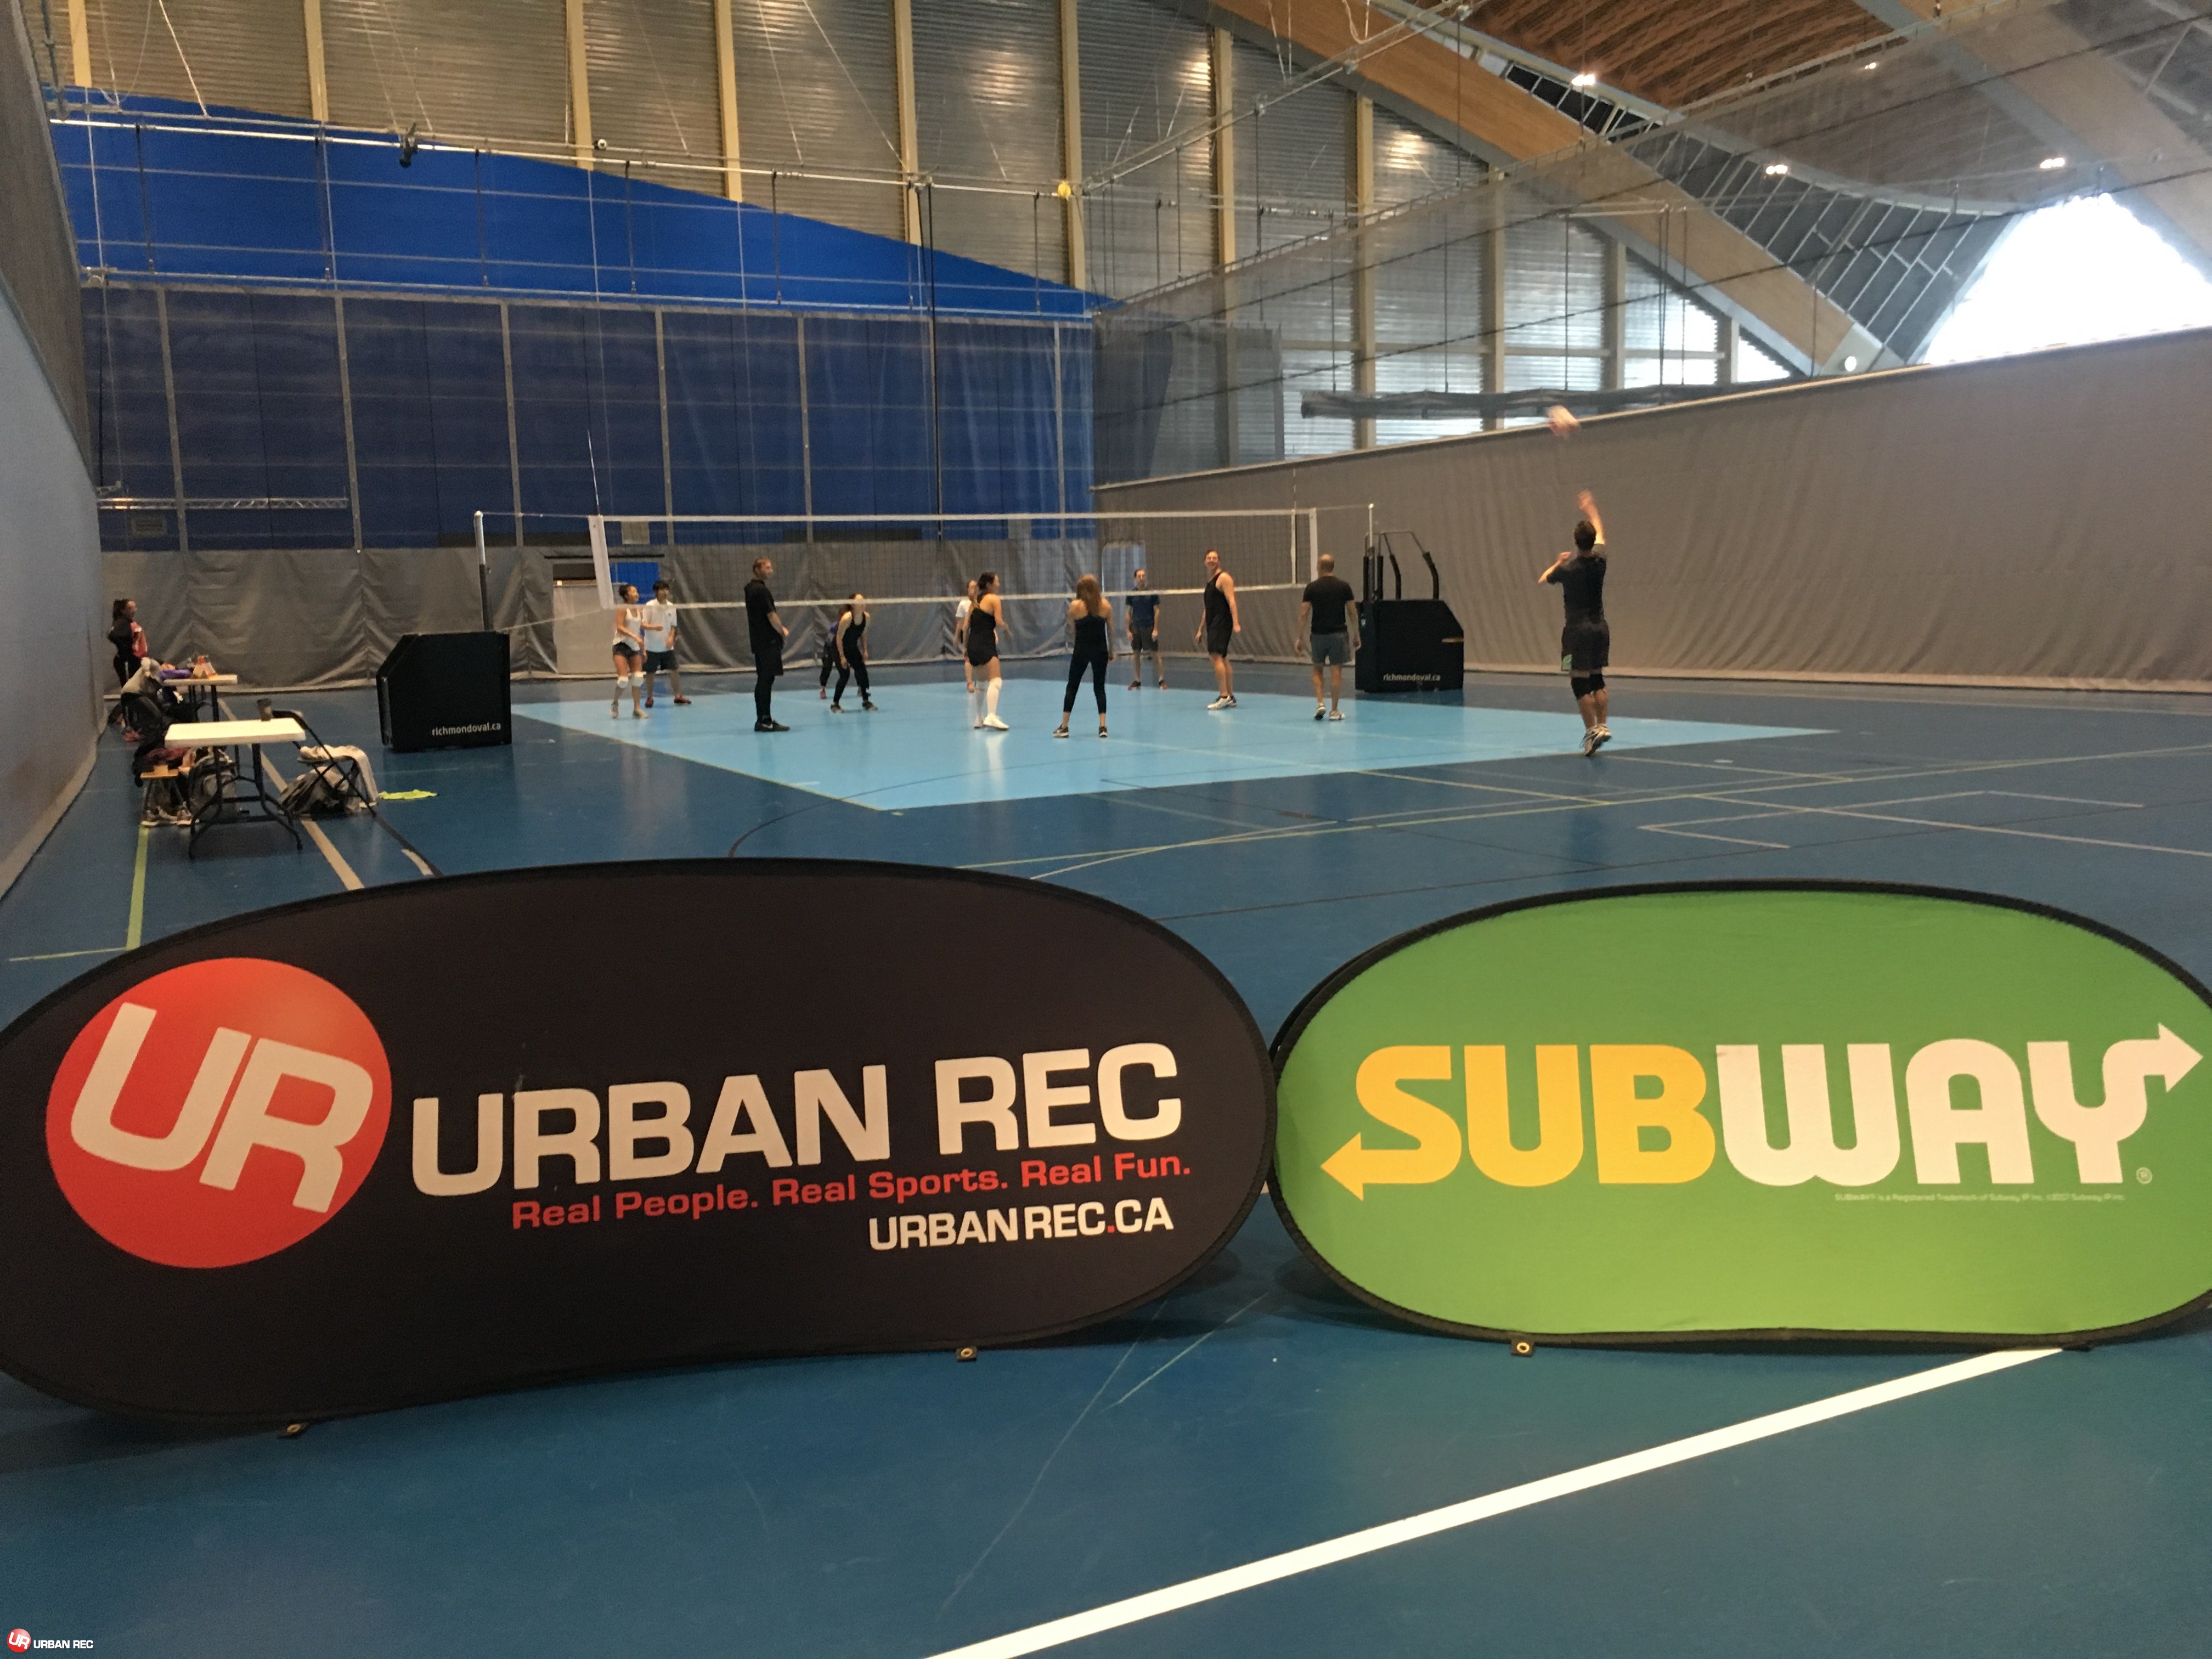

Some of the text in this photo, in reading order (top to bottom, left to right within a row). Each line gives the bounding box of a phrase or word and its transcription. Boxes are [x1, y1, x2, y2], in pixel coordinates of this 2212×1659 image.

[1383, 673, 1441, 681] richmondoval.ca
[431, 722, 501, 736] richmondoval.ca
[71, 1002, 374, 1214] UR
[412, 1042, 1182, 1197] URBAN REC
[1321, 1023, 2204, 1201] SUBWAY
[512, 1152, 1191, 1229] Real People. Real Sports. Real Fun.
[868, 1197, 1175, 1251] URBANREC.CA
